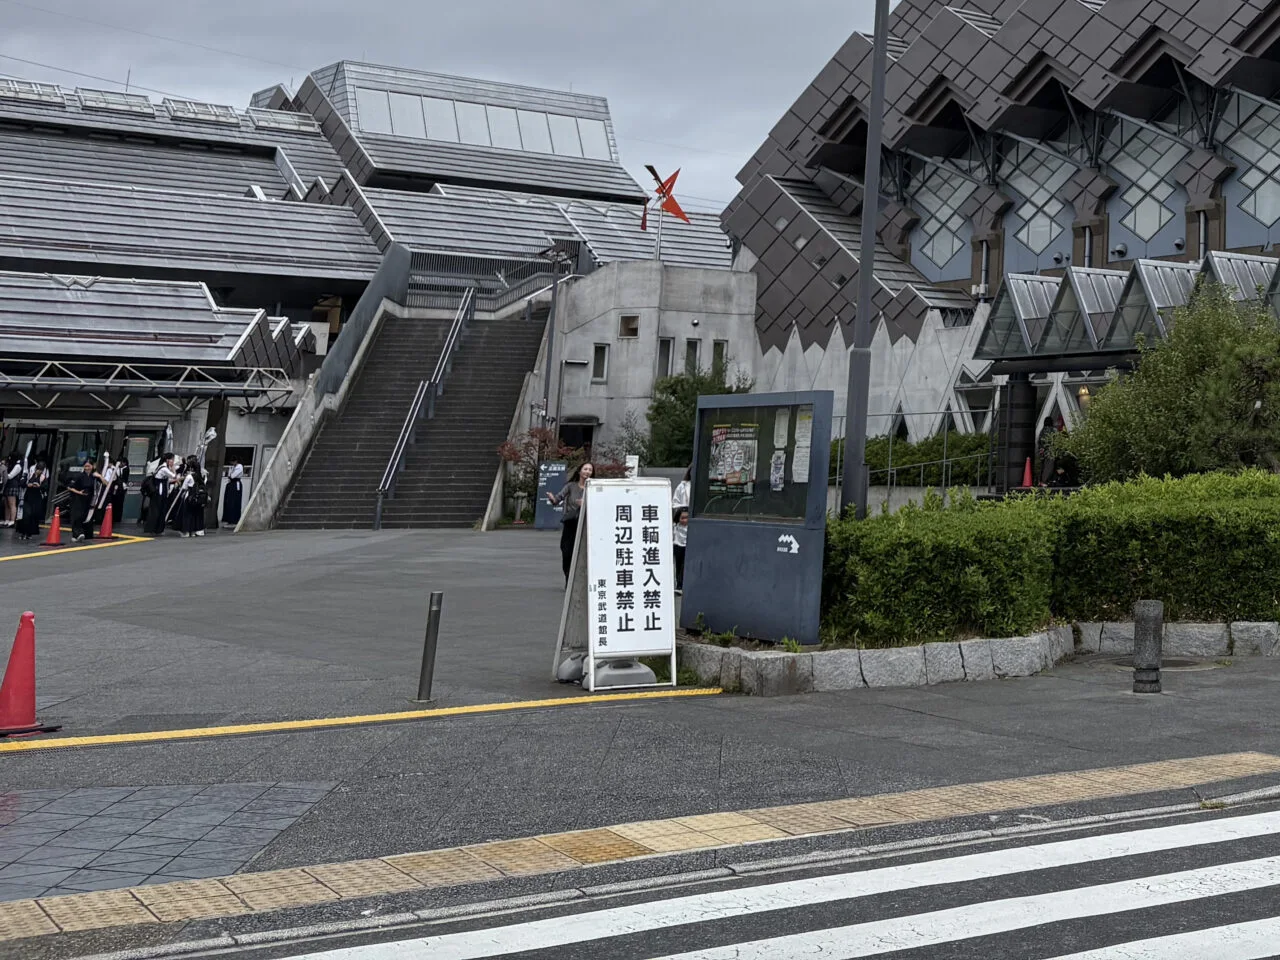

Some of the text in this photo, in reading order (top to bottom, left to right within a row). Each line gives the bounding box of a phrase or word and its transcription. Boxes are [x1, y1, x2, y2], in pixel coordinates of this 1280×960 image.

[597, 579, 608, 647] 東京武道館長
[614, 504, 635, 633] 周辺駐車禁止
